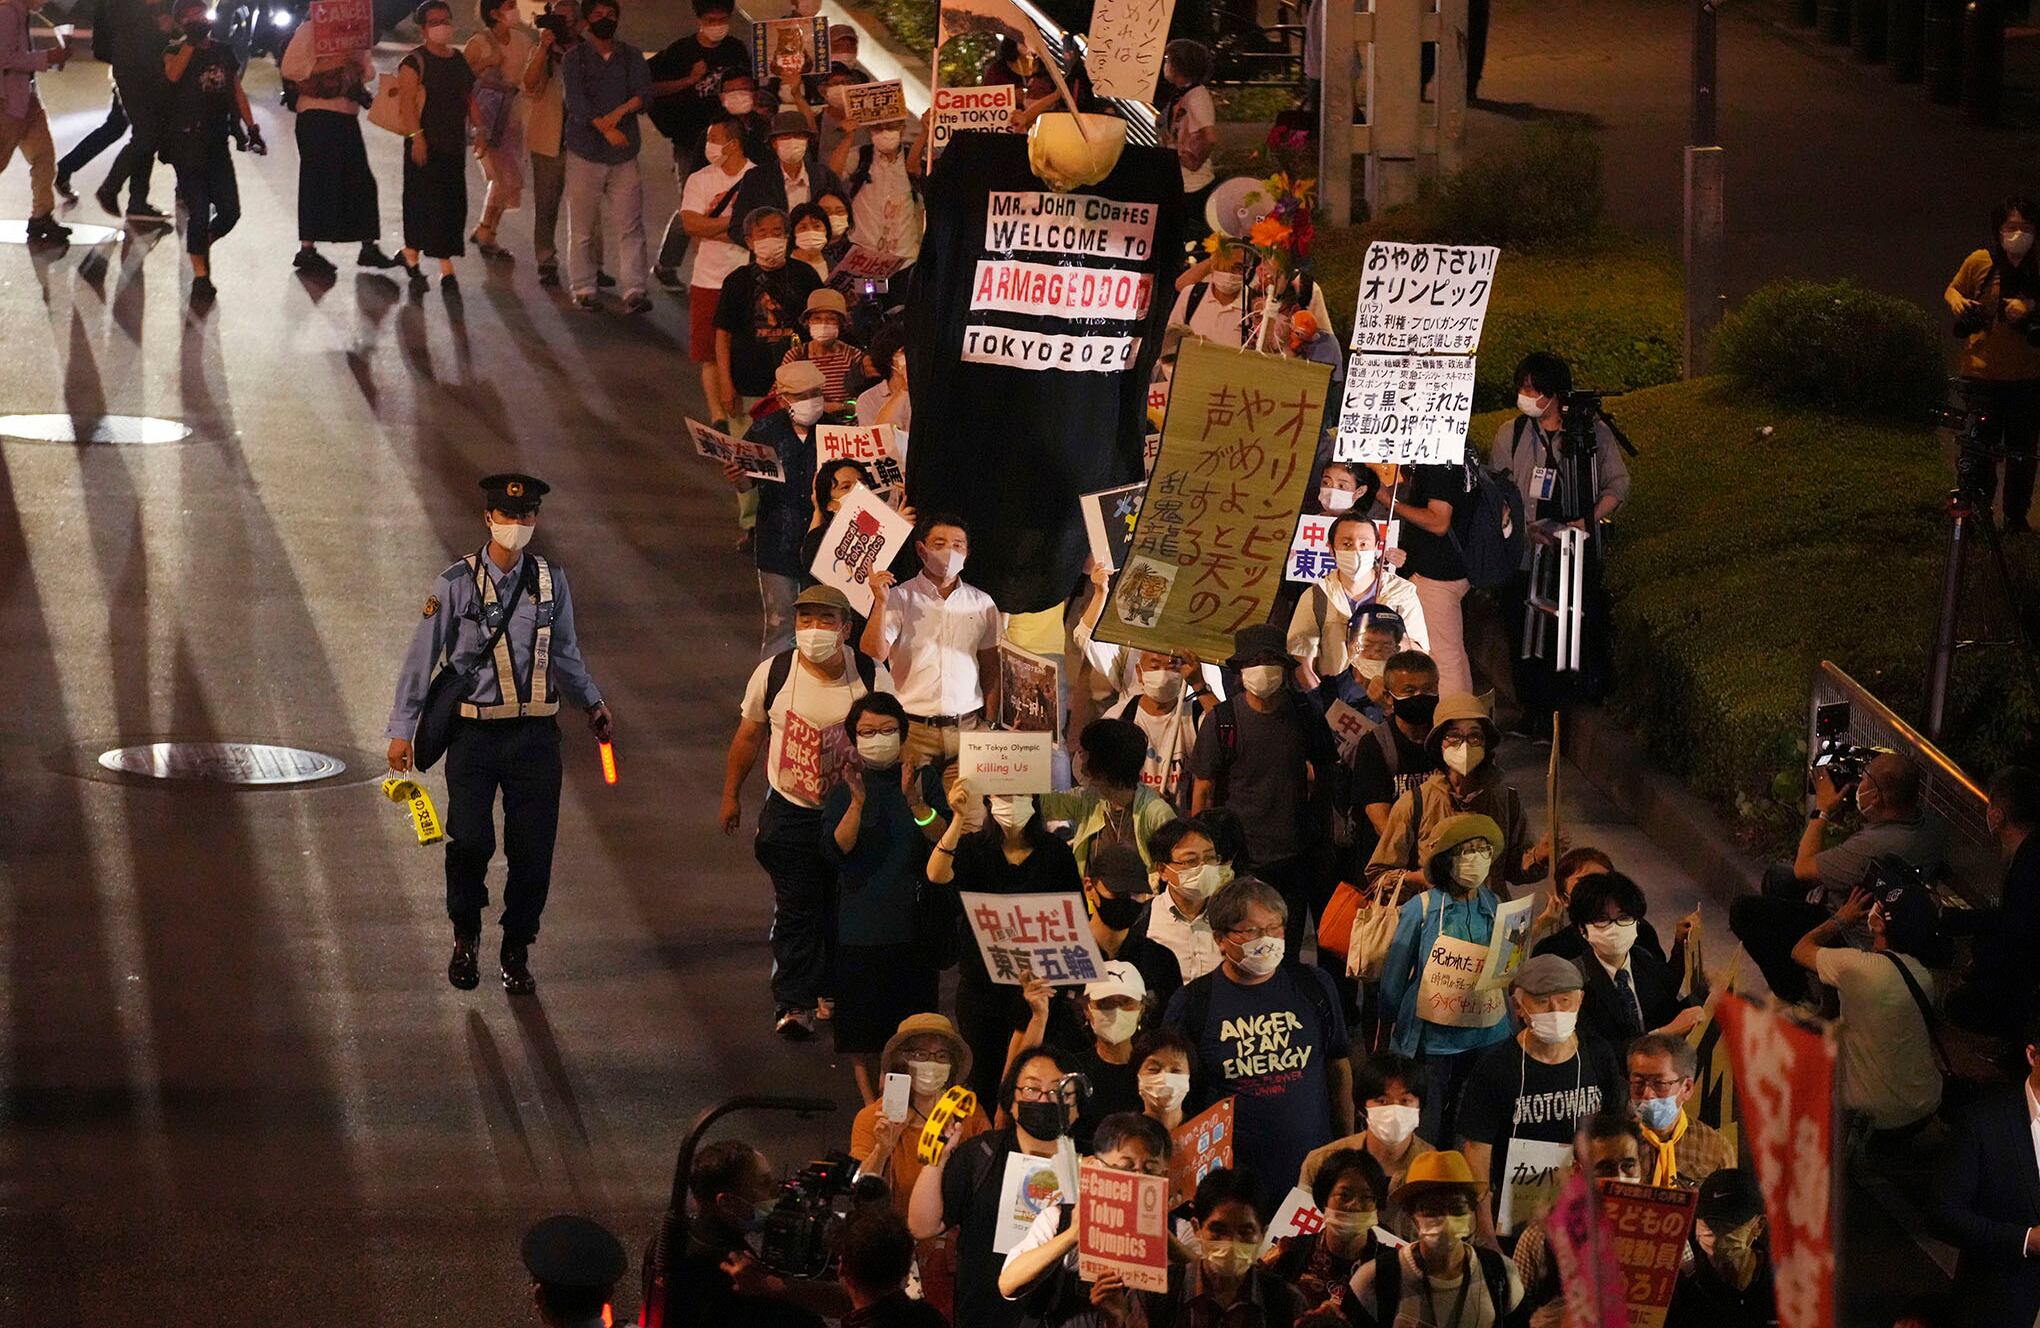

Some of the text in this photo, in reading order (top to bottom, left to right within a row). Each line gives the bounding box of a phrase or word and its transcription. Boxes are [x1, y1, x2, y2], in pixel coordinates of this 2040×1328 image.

[935, 88, 1011, 109] Cancel
[939, 110, 1008, 124] the TOKYO
[993, 220, 1108, 252] WELCOME
[1364, 275, 1488, 307] オリンピック
[824, 428, 887, 459] 中止だ!
[1222, 389, 1319, 634] オリンピック
[834, 519, 858, 561] Cancel
[846, 533, 869, 568] Tokyo
[854, 535, 885, 585] Olympics
[789, 719, 845, 748] オリンピッ
[968, 743, 1041, 753] The Tokyo Olympic
[976, 762, 1028, 774] Killing Us
[974, 900, 1079, 943] 中止だ!
[987, 945, 1098, 980] 東京五輪
[1220, 1011, 1303, 1041] ANGER
[1237, 1031, 1289, 1057] IS AN
[1223, 1046, 1312, 1079] ENERGY
[1080, 1173, 1132, 1202] #Cancel
[1090, 1200, 1124, 1228] Tokyo
[1088, 1226, 1146, 1258] Olympics
